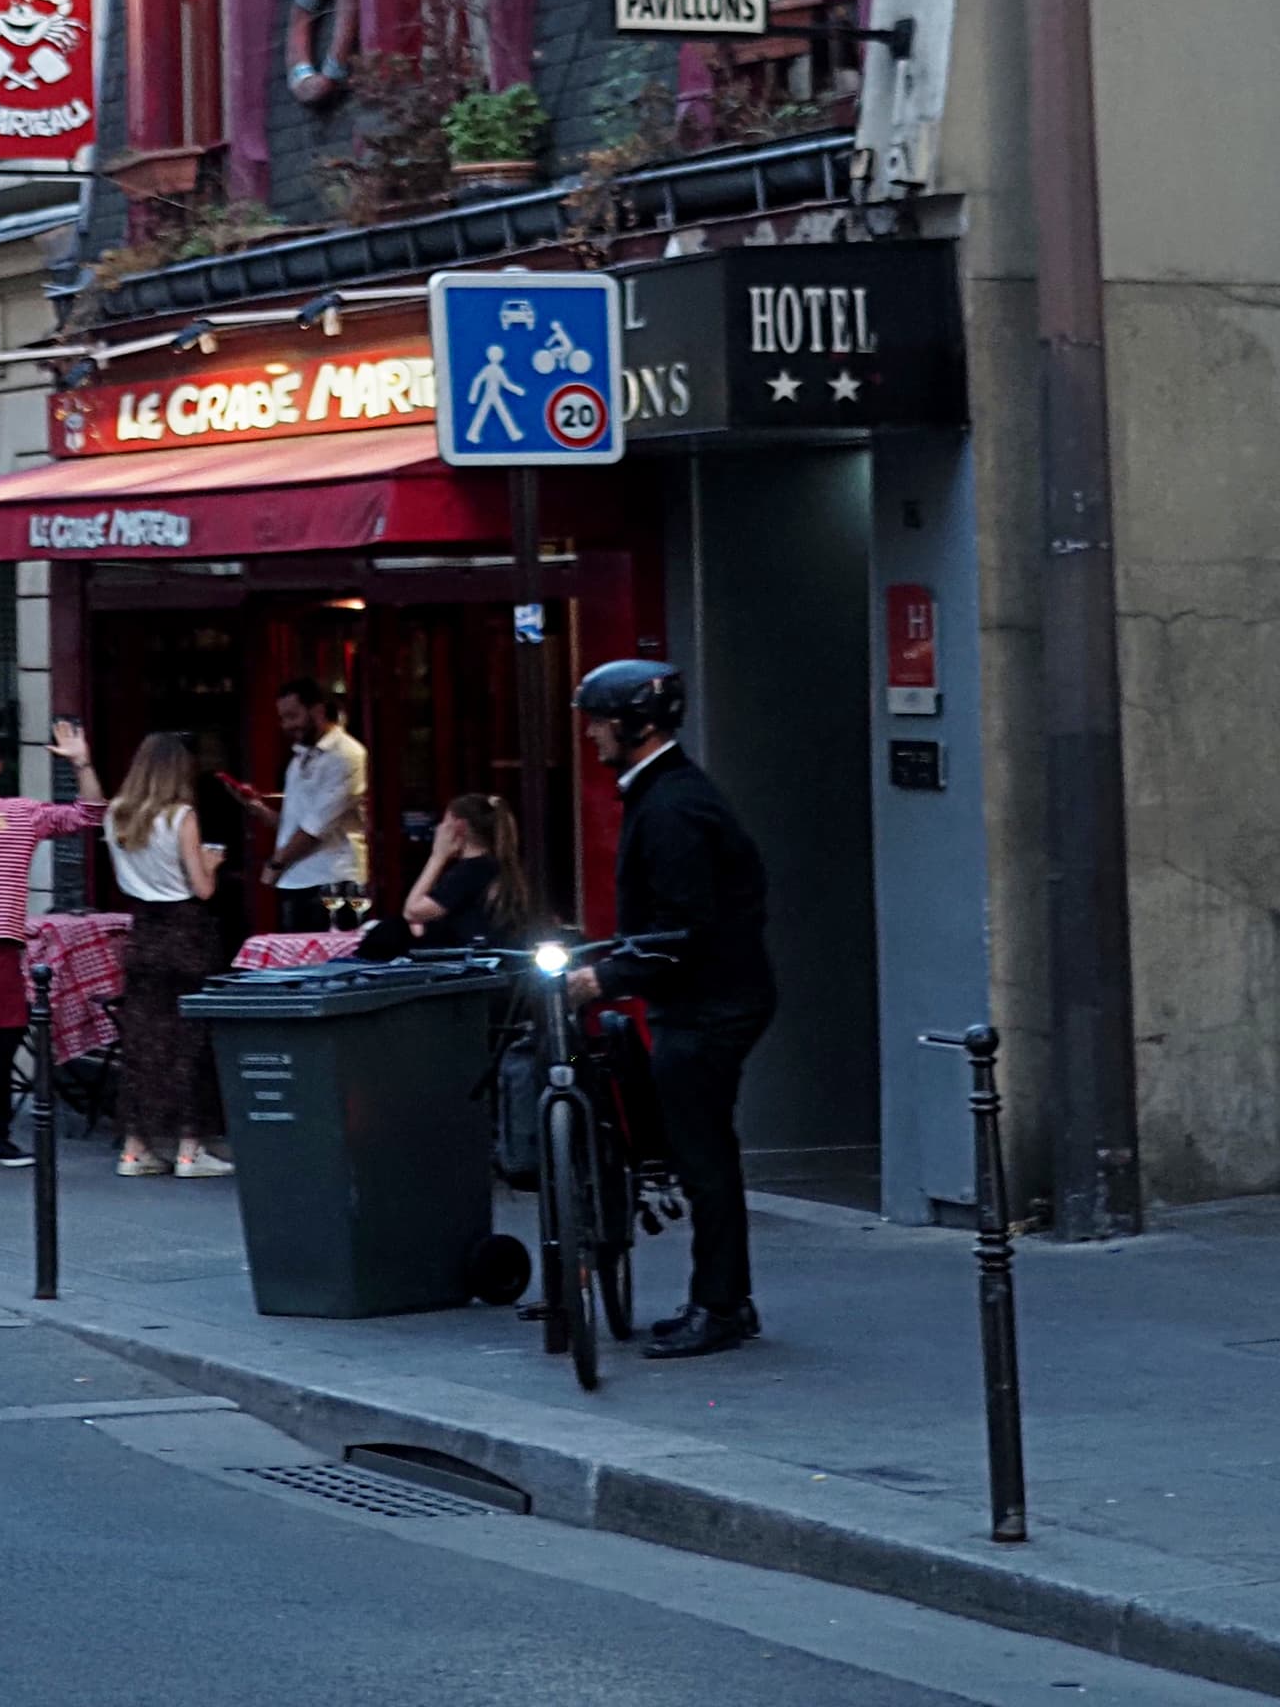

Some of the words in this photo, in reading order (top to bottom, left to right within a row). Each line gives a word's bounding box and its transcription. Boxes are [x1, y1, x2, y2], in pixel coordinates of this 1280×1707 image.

[748, 286, 878, 354] HOTEL
[117, 392, 164, 441] LE
[165, 371, 303, 436] CRABE
[305, 356, 437, 421] MART
[560, 404, 595, 428] 20
